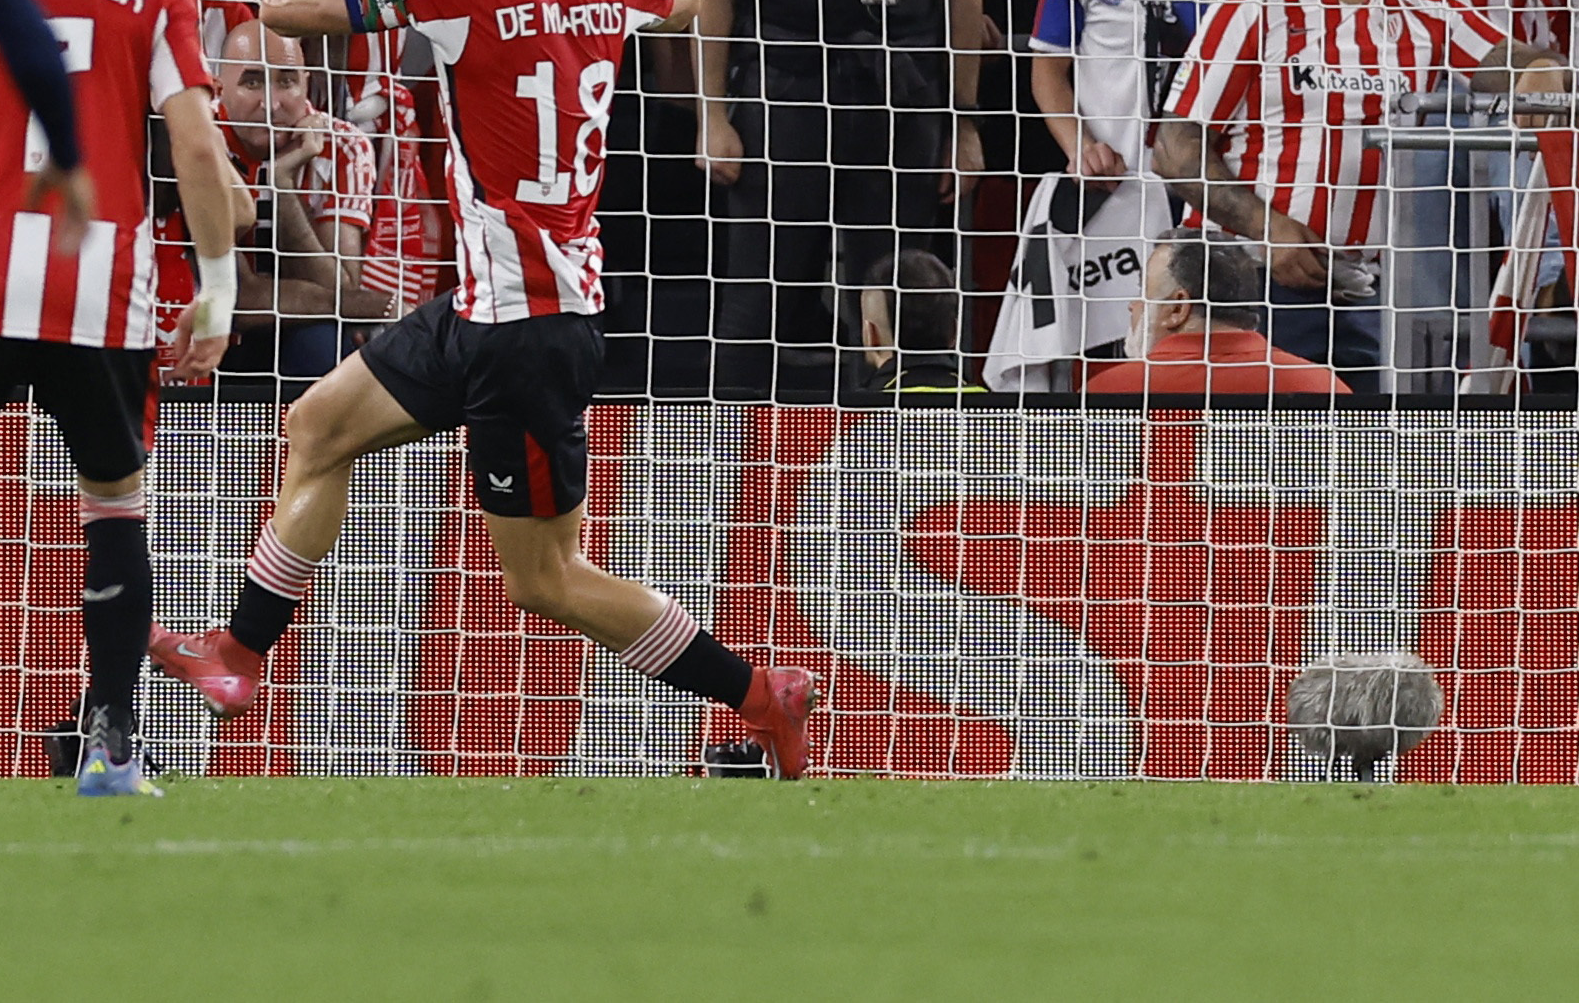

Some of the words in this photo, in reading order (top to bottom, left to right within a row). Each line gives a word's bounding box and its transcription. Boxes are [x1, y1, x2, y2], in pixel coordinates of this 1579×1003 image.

[495, 2, 537, 40] DE
[541, 2, 624, 37] MARCOS
[516, 59, 615, 205] 18
